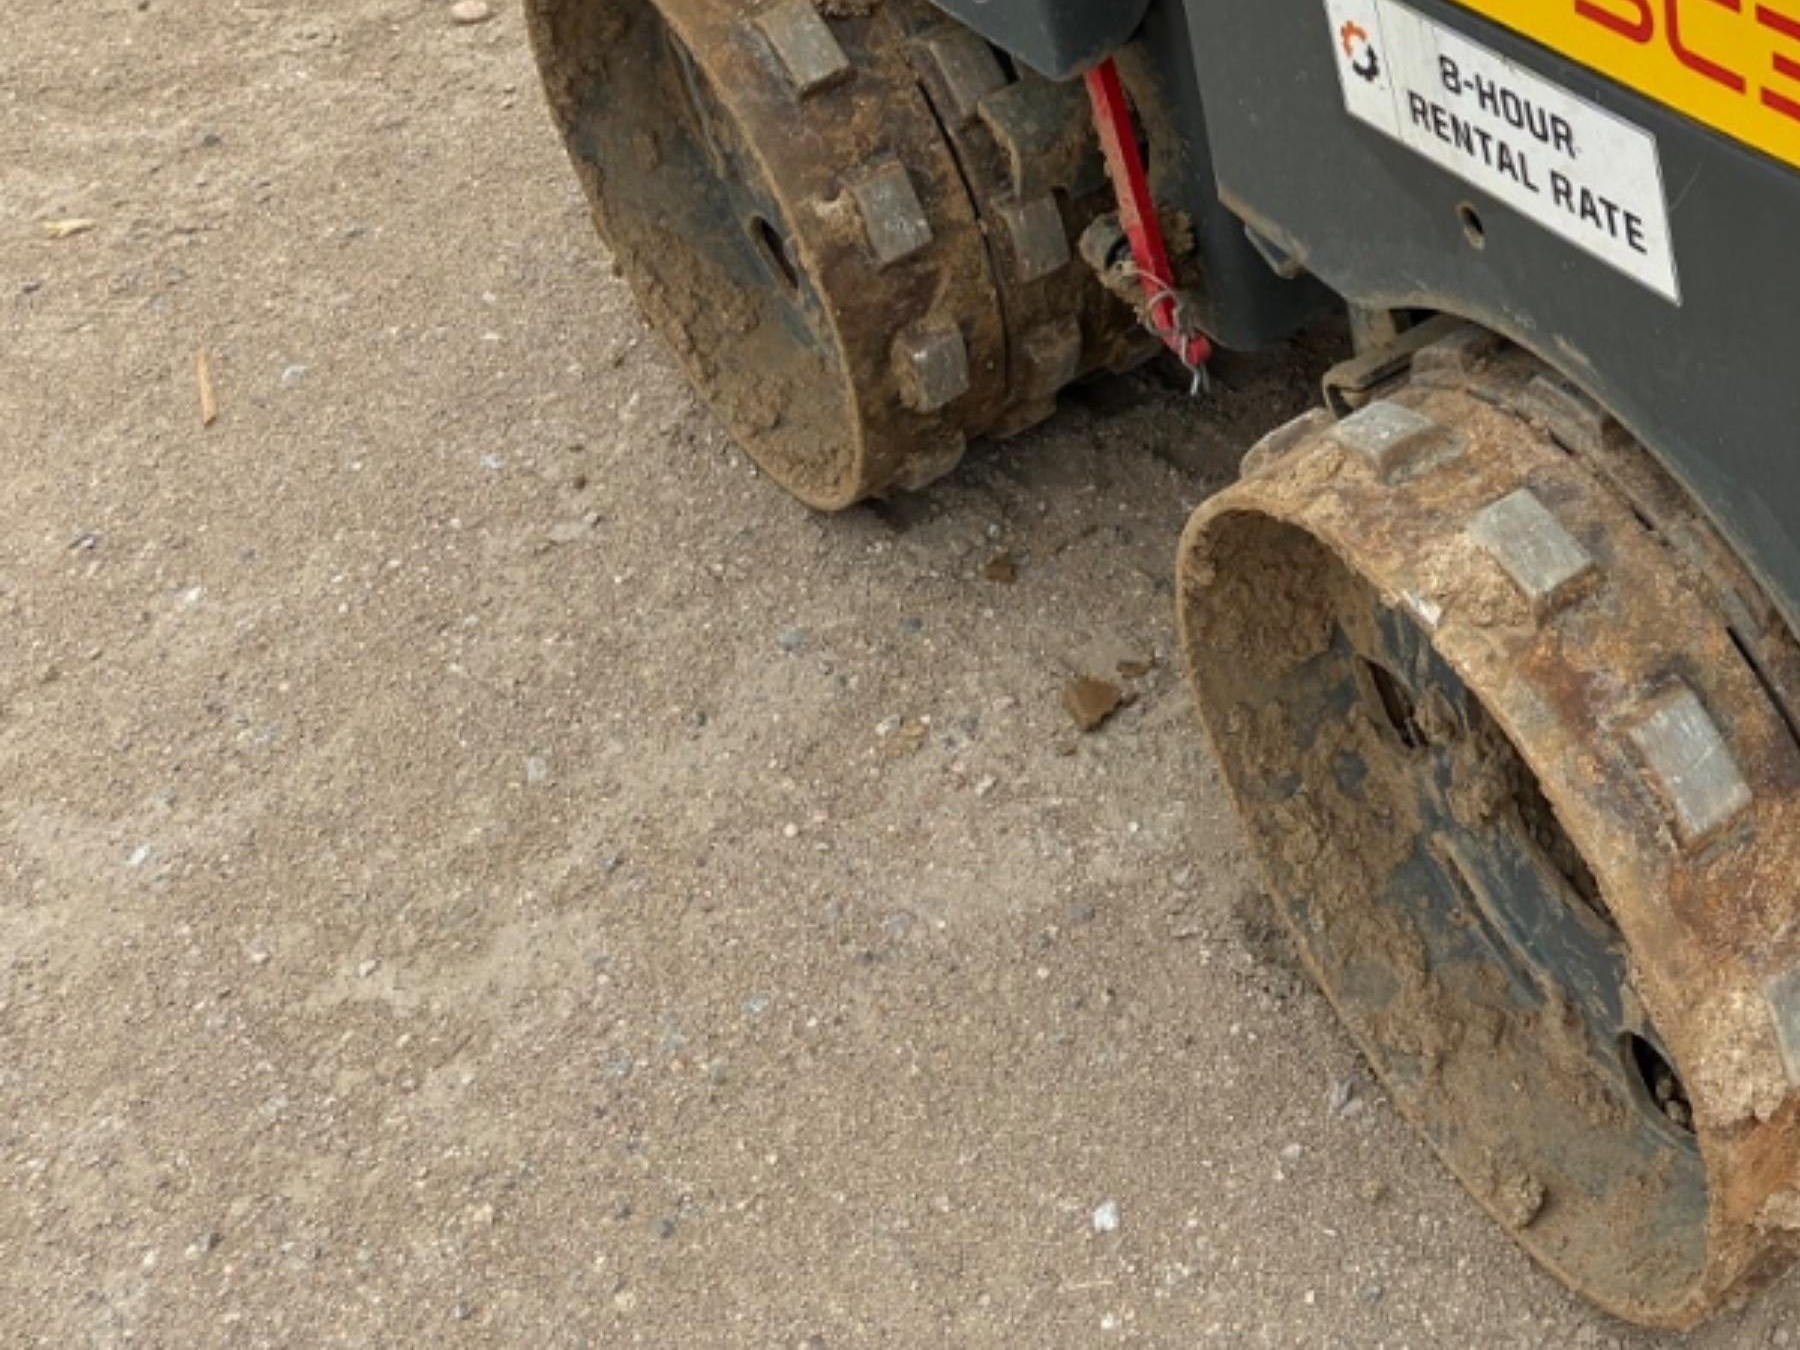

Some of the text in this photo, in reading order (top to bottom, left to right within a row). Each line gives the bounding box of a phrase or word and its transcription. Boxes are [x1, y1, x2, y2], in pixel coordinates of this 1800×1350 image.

[1408, 90, 1648, 255] RENTAL RATE
[1438, 53, 1576, 160] 8-HOUR
